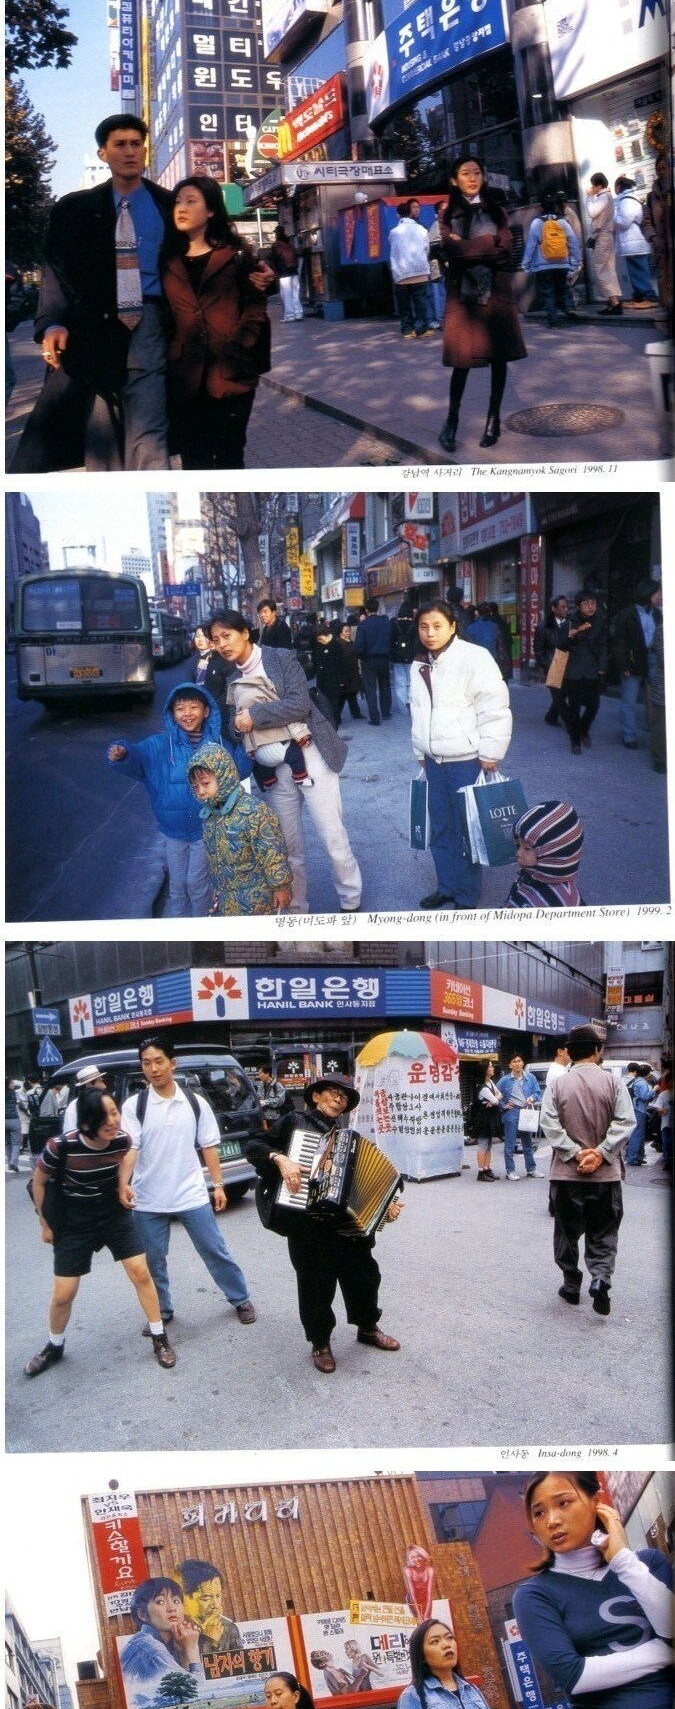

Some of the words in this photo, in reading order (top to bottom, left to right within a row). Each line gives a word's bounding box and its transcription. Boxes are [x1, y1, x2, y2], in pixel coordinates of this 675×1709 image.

[433, 50, 451, 66] BANK
[489, 805, 518, 820] LOTTE
[255, 977, 380, 1000] 한일은행
[92, 983, 154, 1017] 한일은행
[257, 1000, 296, 1009] HANIL
[298, 1000, 334, 1009] BANK
[337, 999, 376, 1009] 인사동지점
[95, 1017, 113, 1025] HANIL
[113, 1013, 131, 1022] BANK
[442, 1007, 458, 1018] Sunday
[527, 1005, 558, 1031] 한일은행
[91, 1493, 133, 1504] 최지우
[94, 1504, 134, 1516] 안재욱
[181, 1496, 300, 1530] 피카디리
[104, 1520, 135, 1580] 키스할까요
[202, 1650, 247, 1680] 남자의
[248, 1645, 275, 1673] 향기
[516, 1651, 538, 1703] 주택은행
